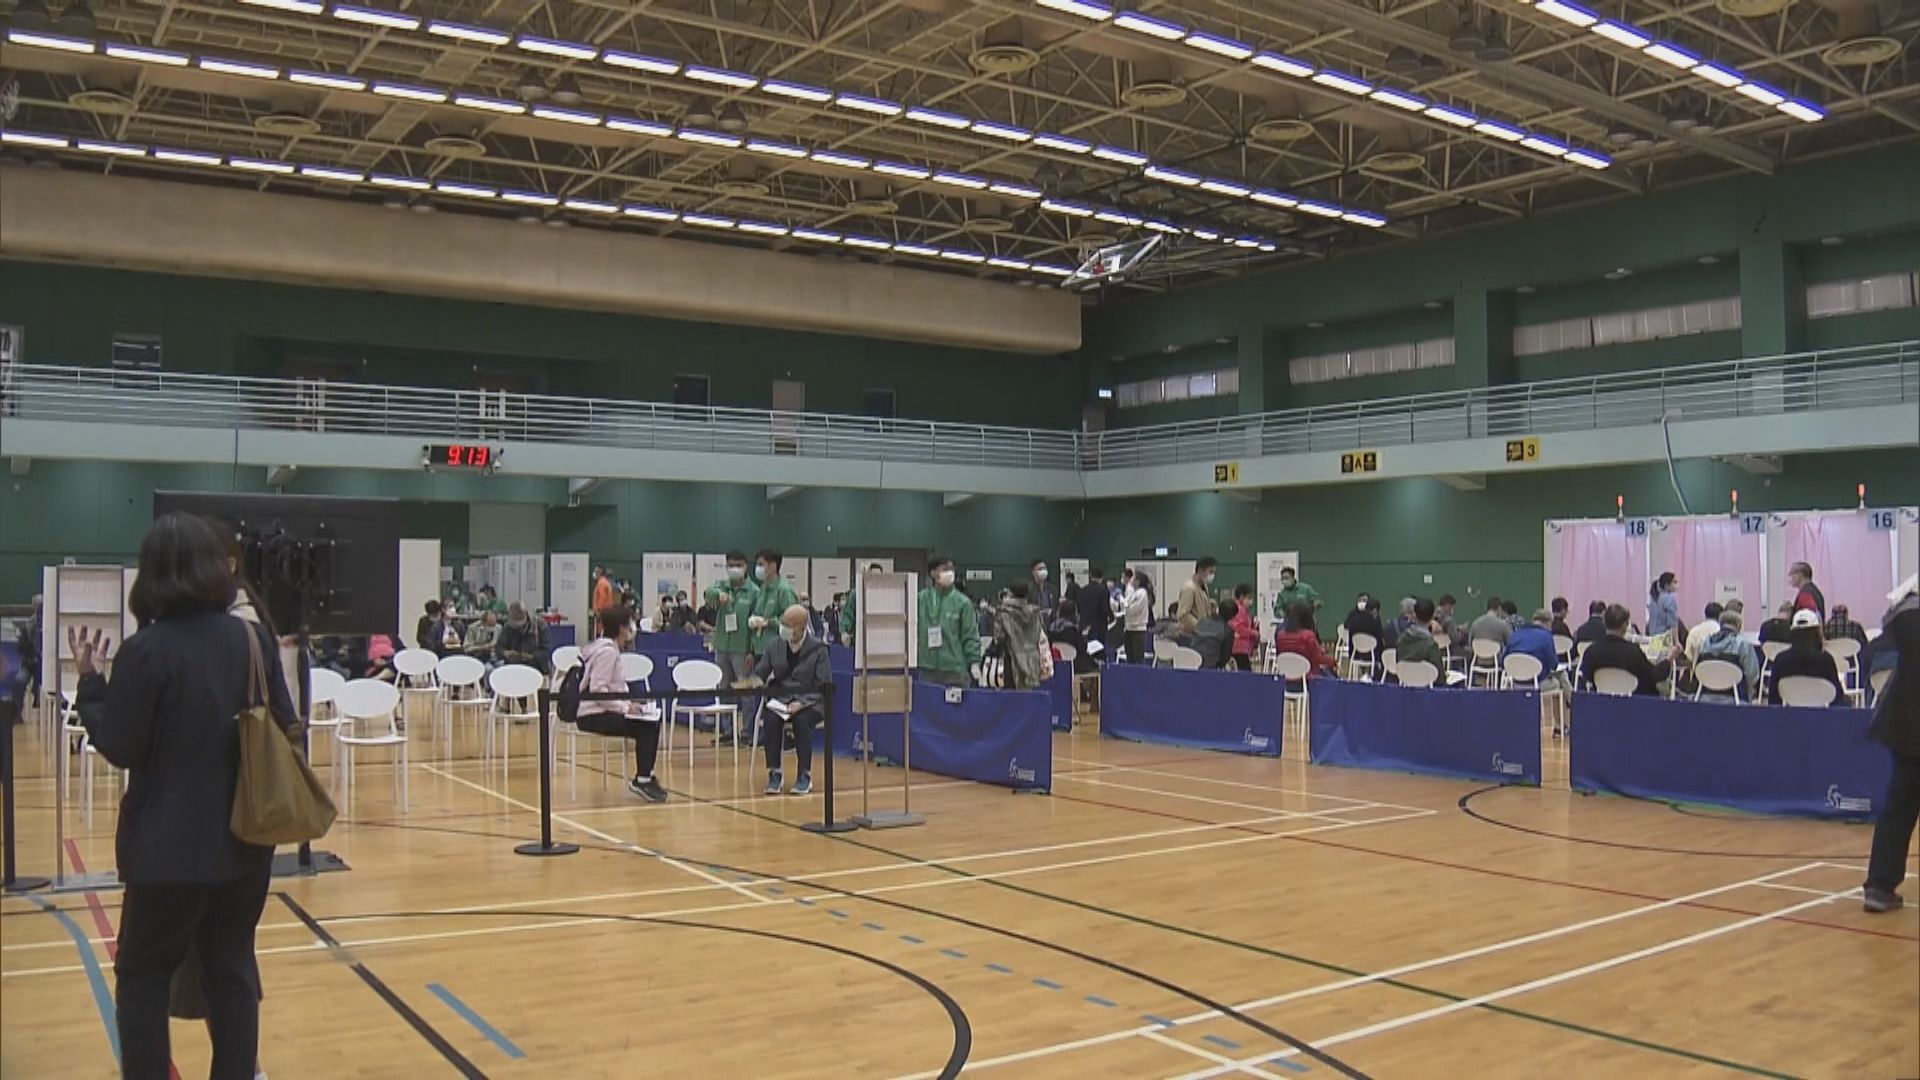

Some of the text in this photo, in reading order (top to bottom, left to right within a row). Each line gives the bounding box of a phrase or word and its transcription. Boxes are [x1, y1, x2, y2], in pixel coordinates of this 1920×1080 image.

[1527, 443, 1536, 458] 3
[1354, 457, 1362, 470] A
[1744, 516, 1762, 532] 17
[1871, 511, 1892, 528] 16
[1629, 520, 1645, 536] 18
